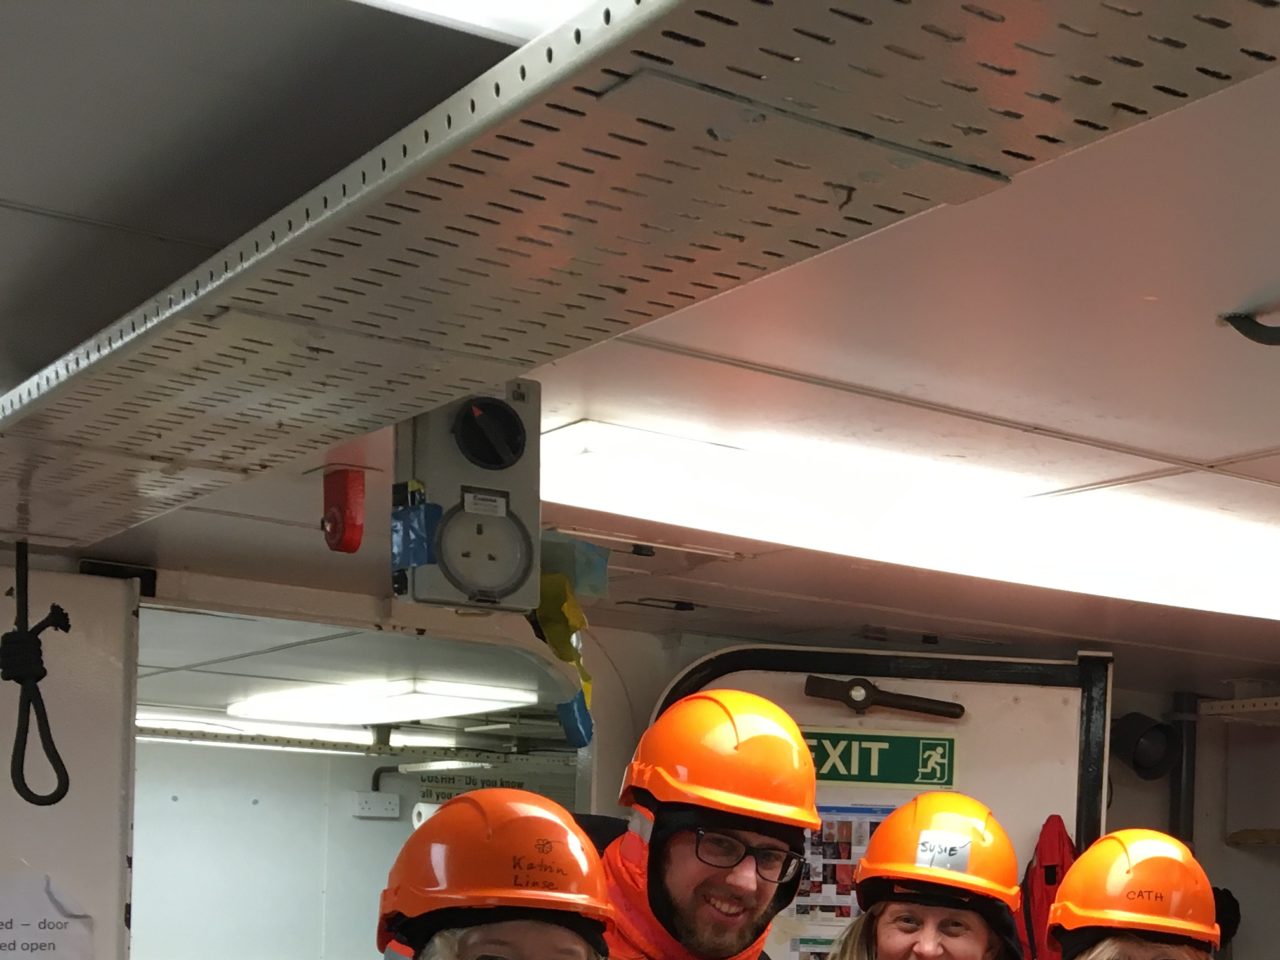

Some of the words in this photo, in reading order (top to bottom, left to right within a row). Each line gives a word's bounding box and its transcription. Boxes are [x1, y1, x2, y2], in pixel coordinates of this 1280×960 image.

[1126, 889, 1164, 902] CATH
[38, 918, 69, 930] door
[21, 942, 56, 953] open
